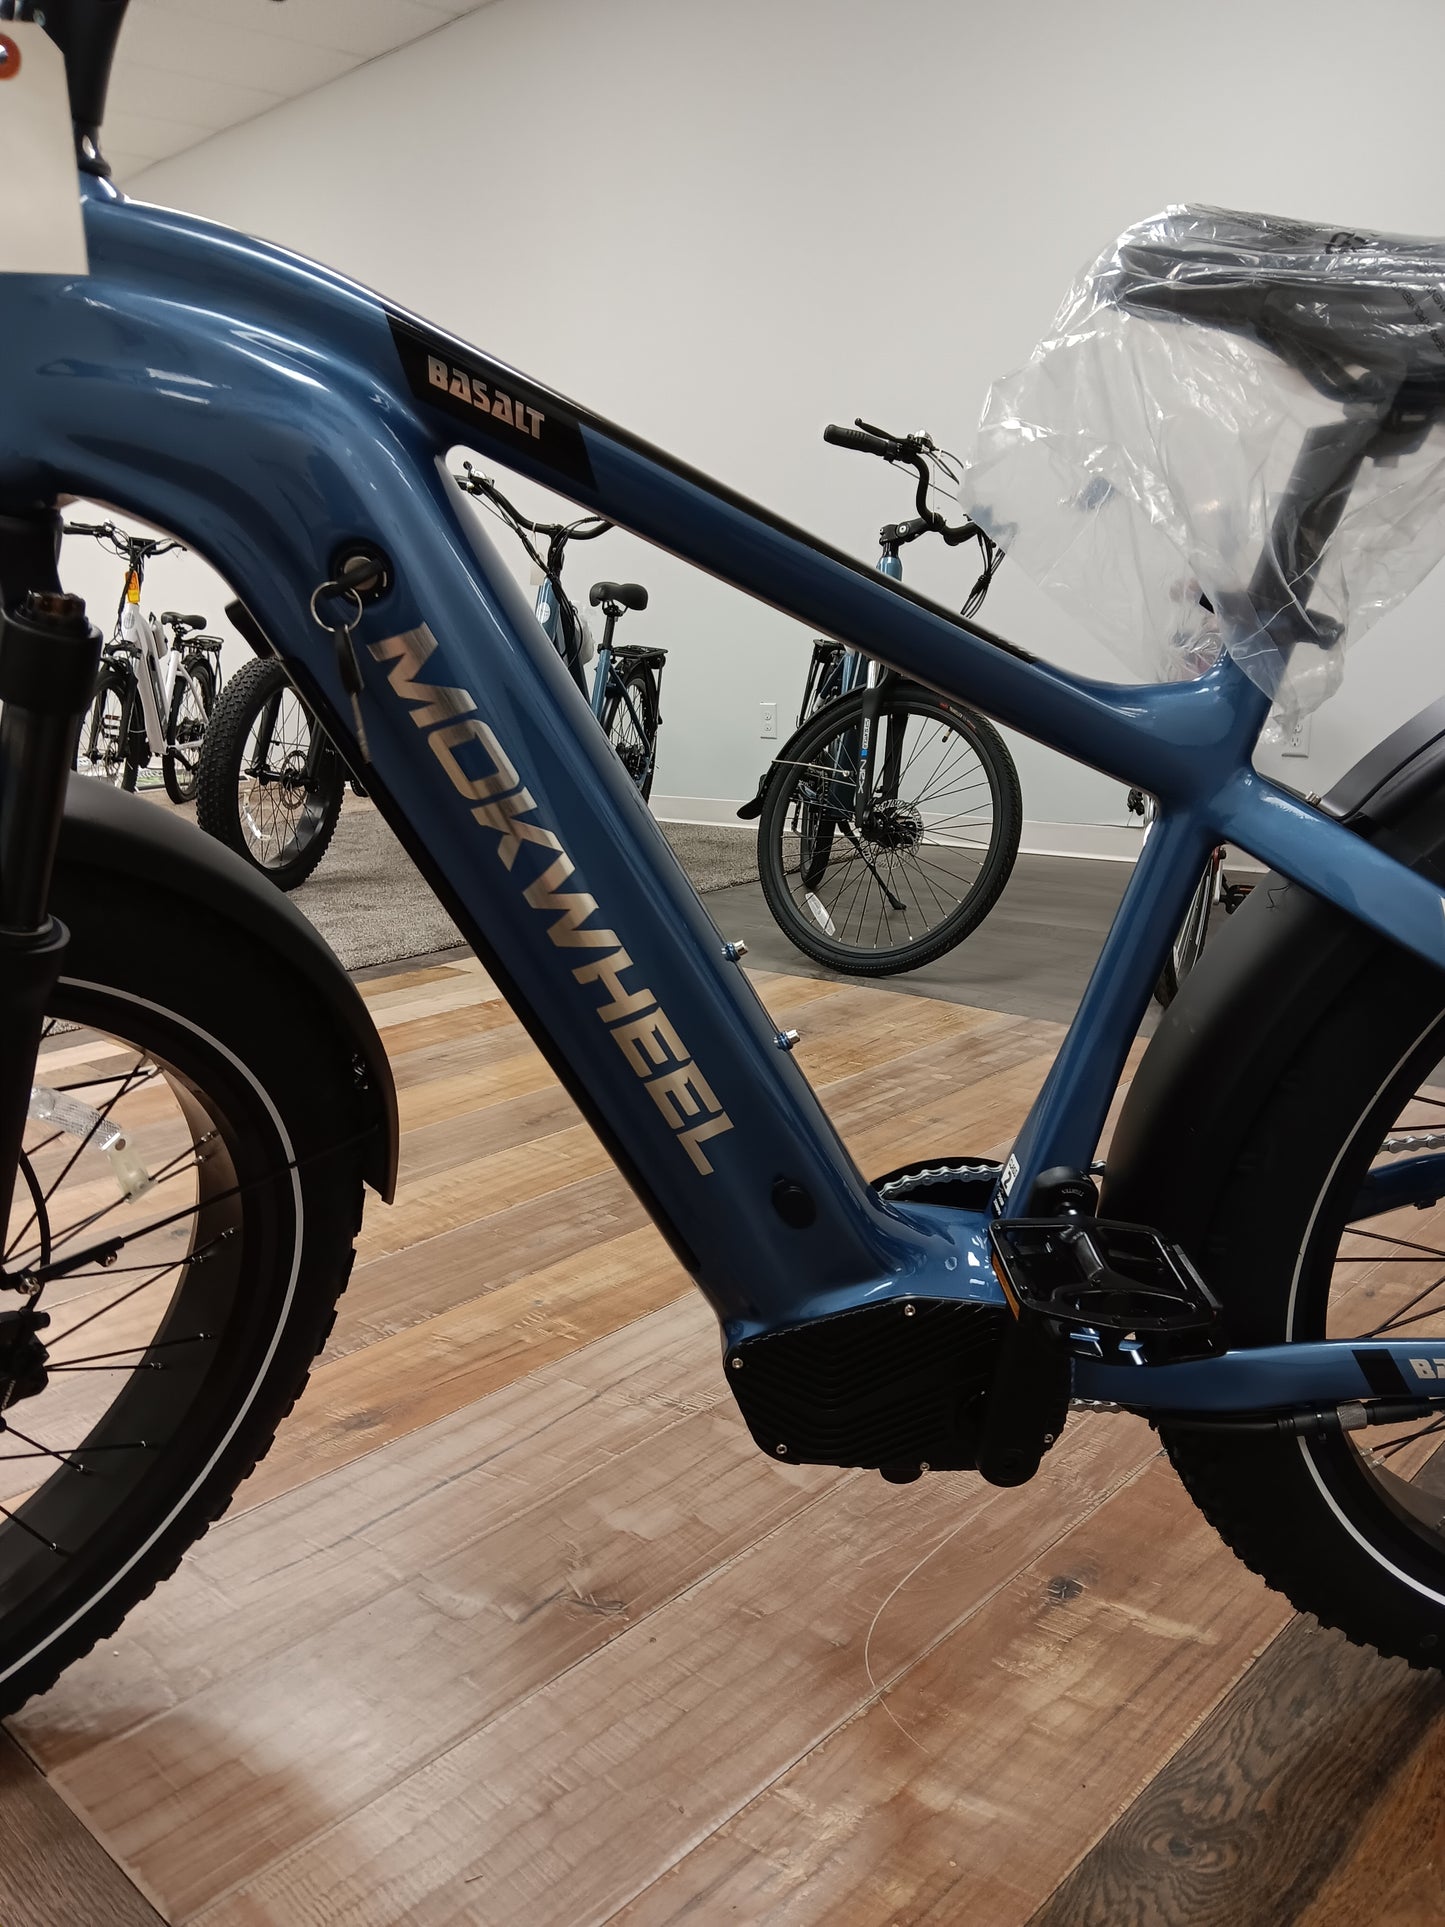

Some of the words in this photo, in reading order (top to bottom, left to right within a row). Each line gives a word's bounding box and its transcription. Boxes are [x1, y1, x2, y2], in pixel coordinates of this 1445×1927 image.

[428, 355, 545, 440] BASALT
[366, 621, 734, 1176] MOKWHEEL
[1003, 1170, 1012, 1190] 2
